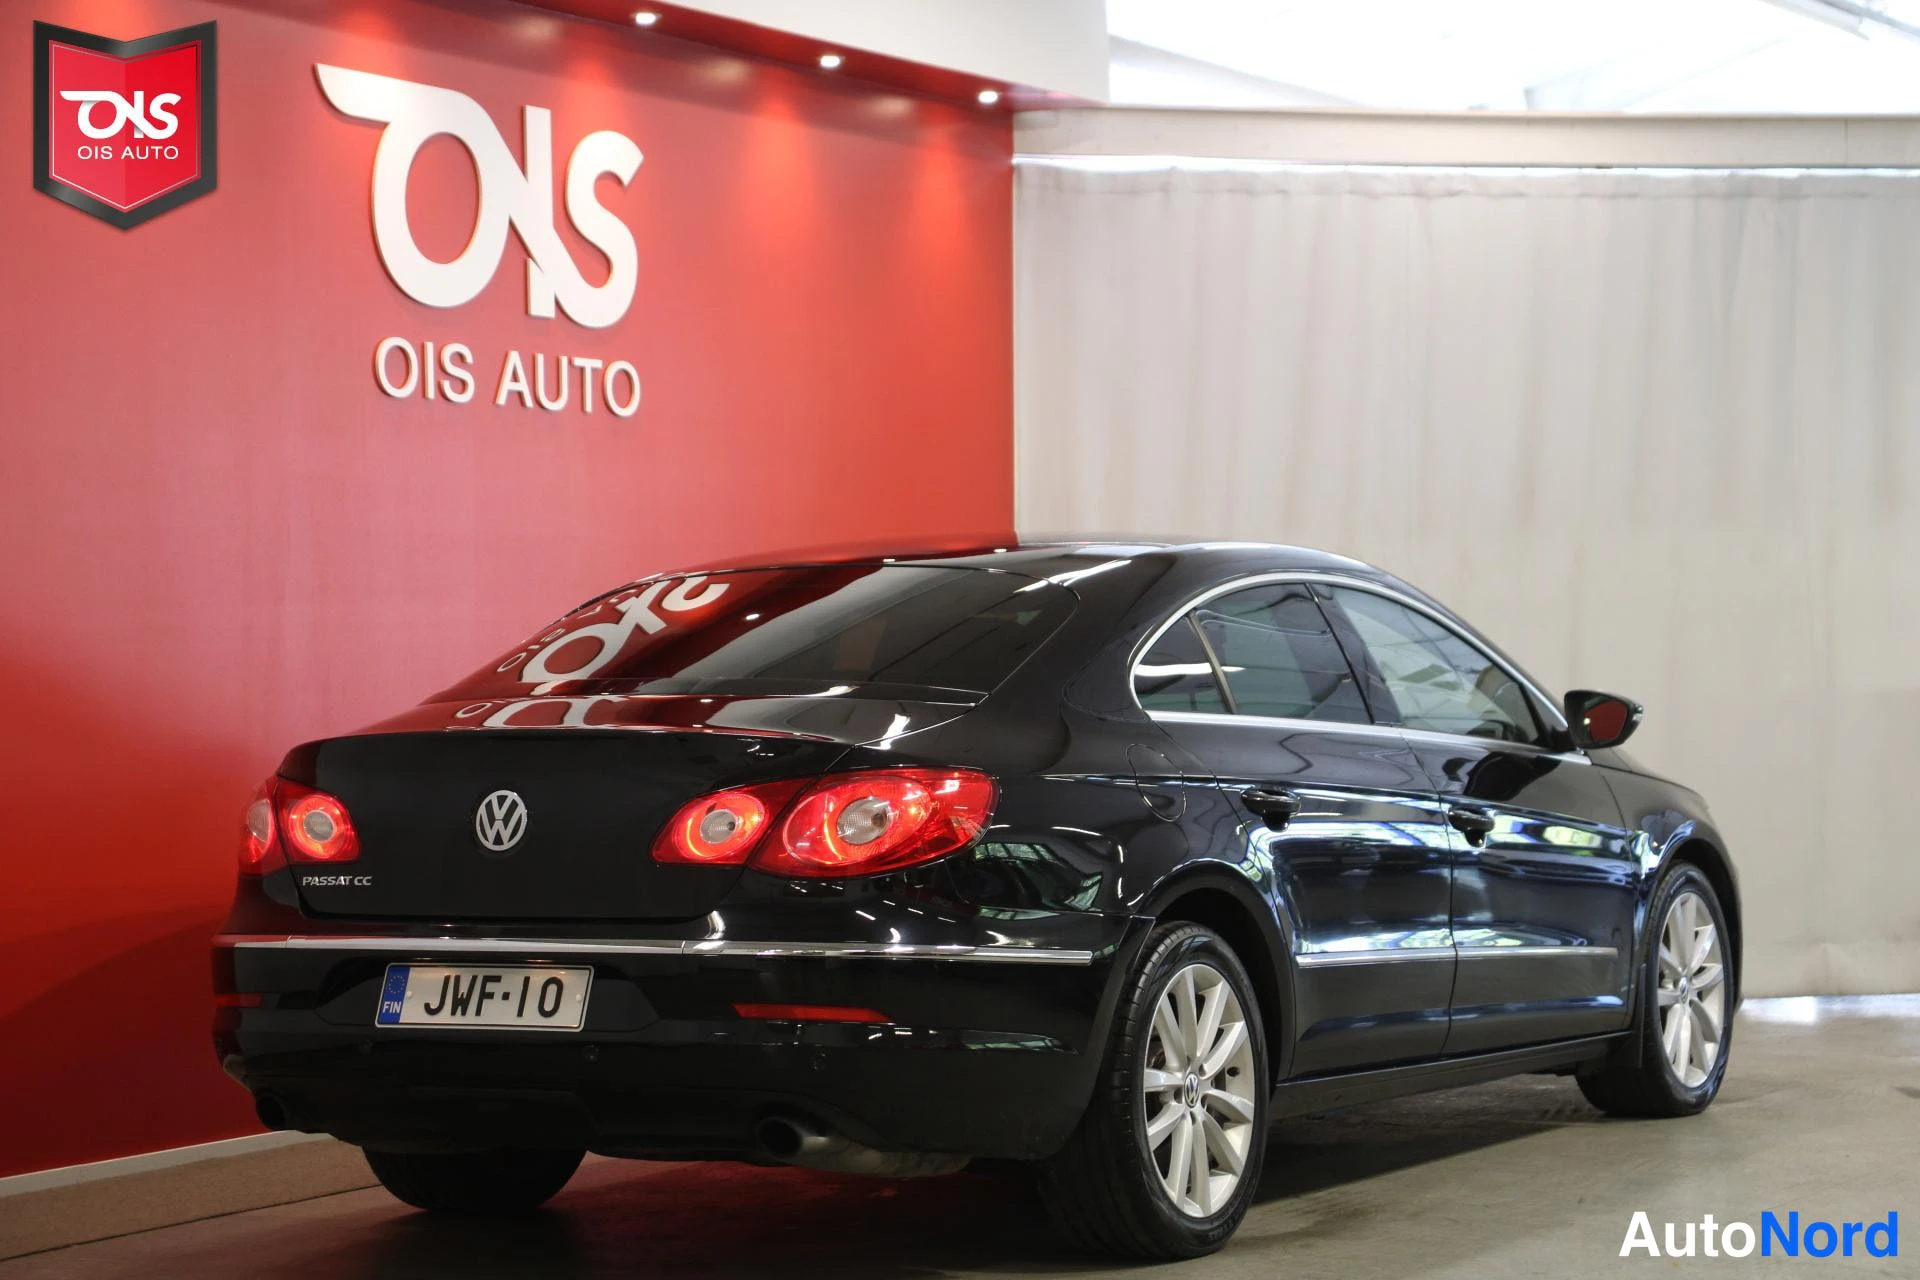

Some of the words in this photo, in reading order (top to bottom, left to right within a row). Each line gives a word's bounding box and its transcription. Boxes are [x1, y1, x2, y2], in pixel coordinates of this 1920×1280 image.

[375, 336, 475, 405] OIS
[496, 350, 642, 418] AUTO
[302, 876, 353, 886] PASSAT
[353, 876, 373, 886] CC
[382, 1001, 401, 1014] FIN
[424, 974, 564, 1018] JWF-10
